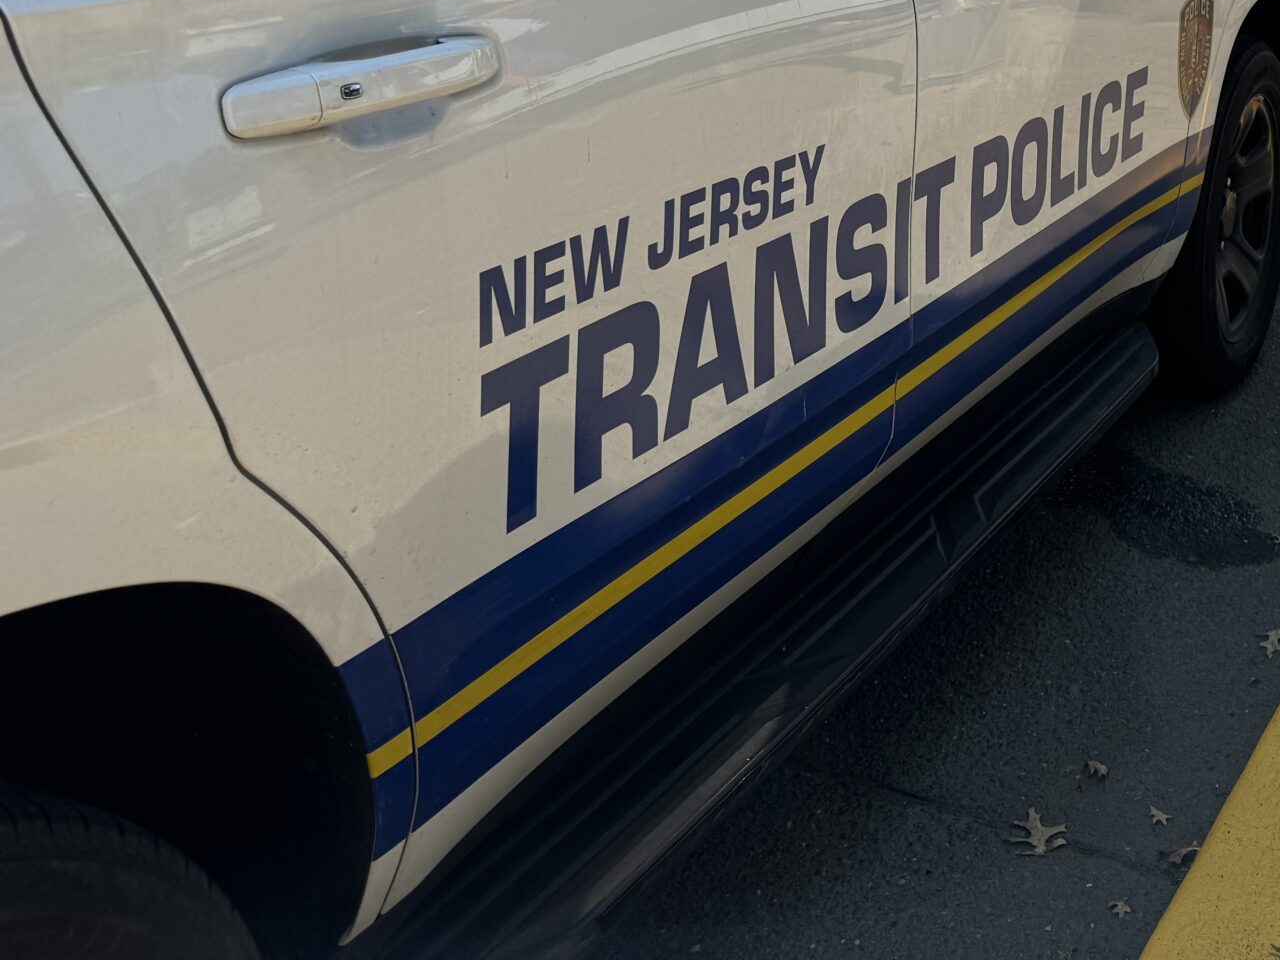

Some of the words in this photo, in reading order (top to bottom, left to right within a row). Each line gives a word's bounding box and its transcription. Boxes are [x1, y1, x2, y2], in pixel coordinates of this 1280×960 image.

[479, 216, 630, 348] NEW
[648, 143, 826, 270] JERSEY
[480, 156, 956, 534] TRANSIT
[970, 66, 1149, 258] POLICE
